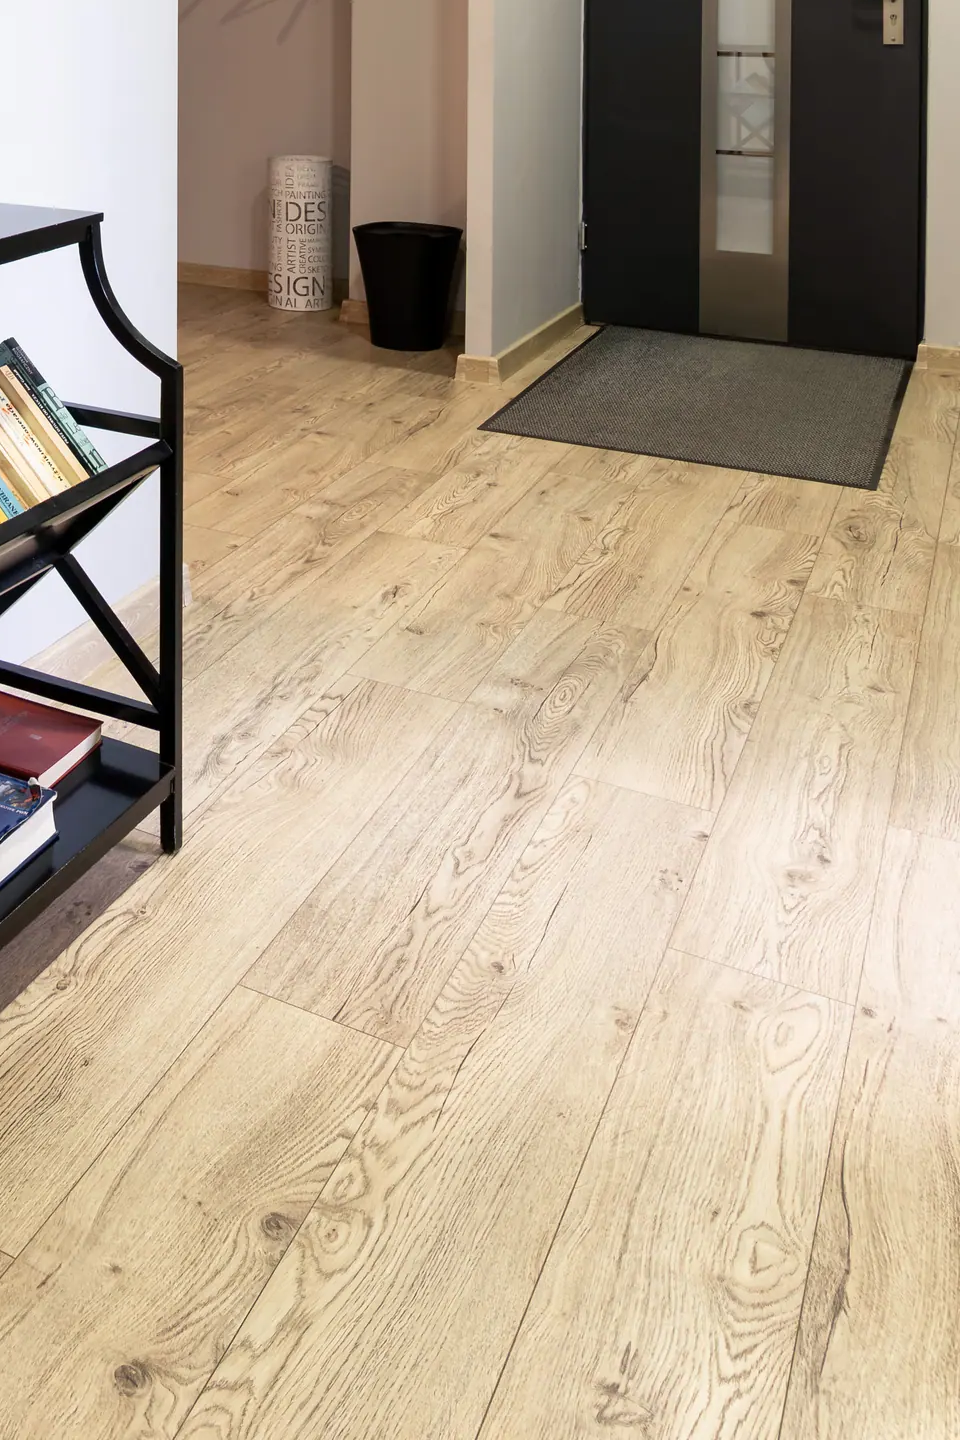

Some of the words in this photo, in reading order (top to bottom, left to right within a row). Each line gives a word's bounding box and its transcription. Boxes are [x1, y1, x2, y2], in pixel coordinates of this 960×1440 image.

[285, 190, 327, 200] PAINTING
[286, 238, 296, 274] ARTIST
[299, 238, 307, 274] CREATIVE
